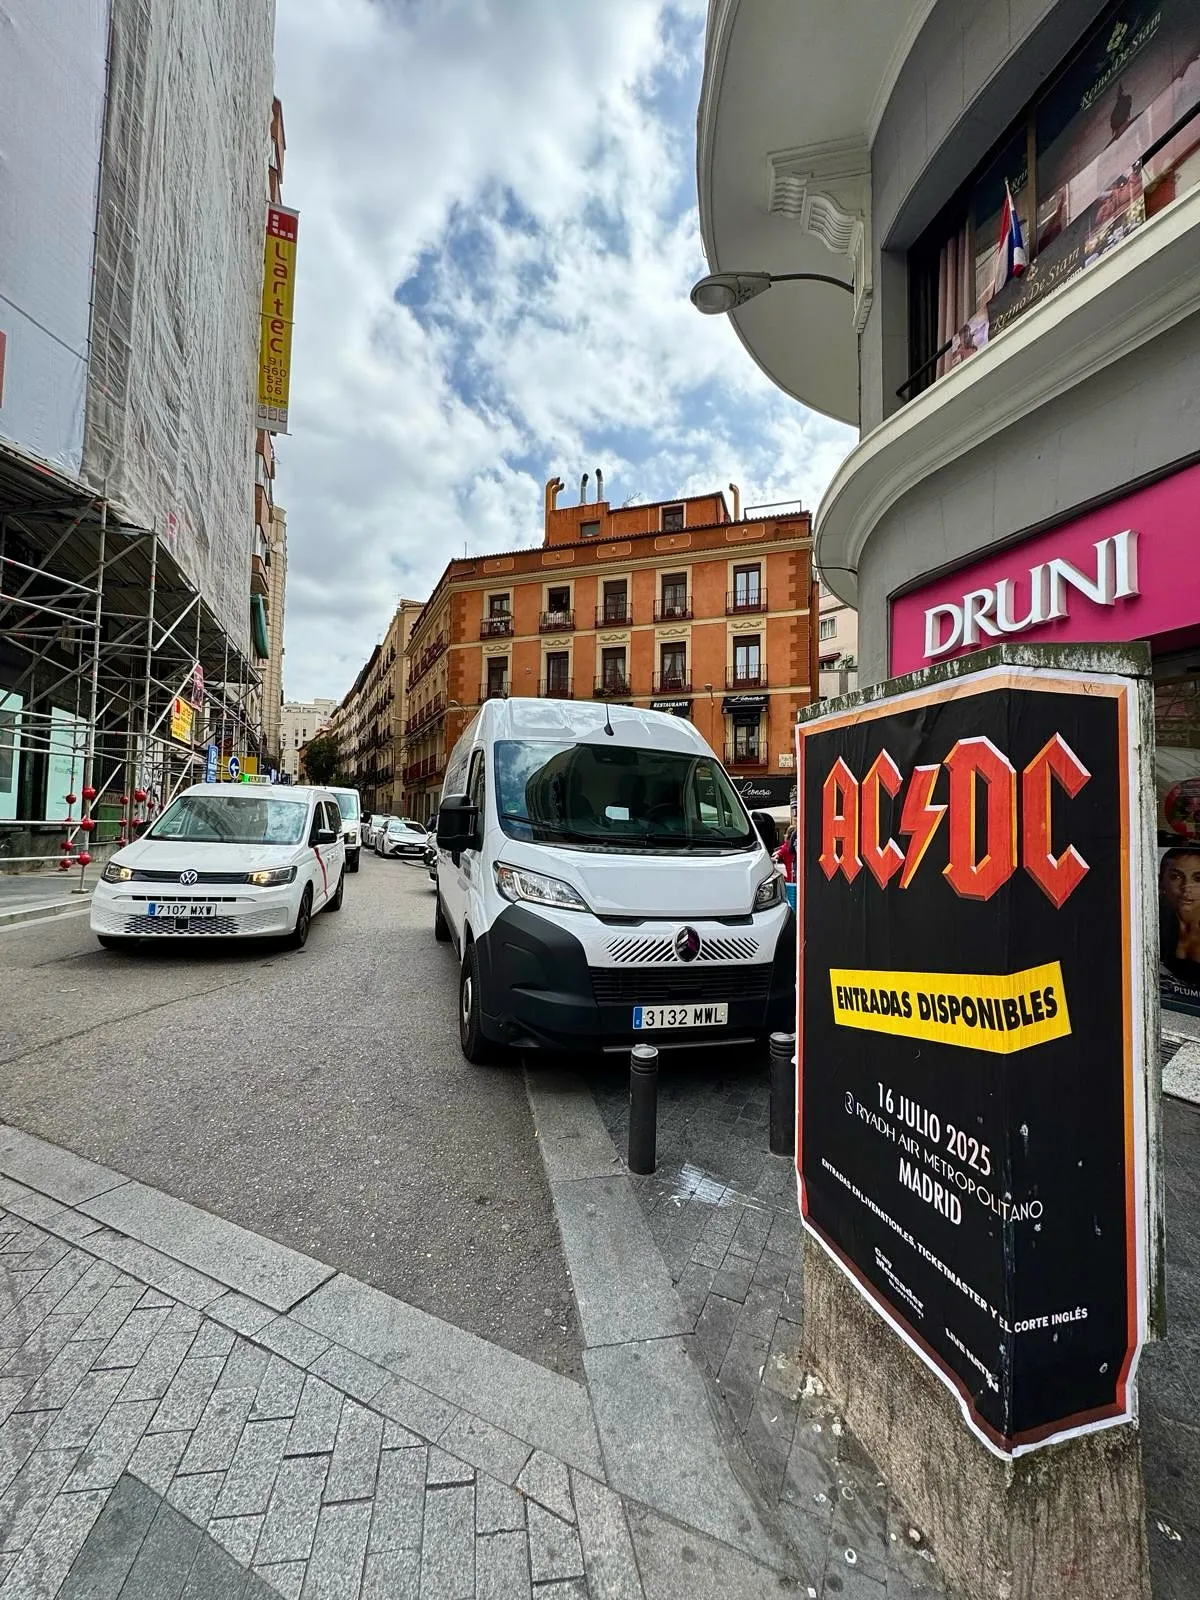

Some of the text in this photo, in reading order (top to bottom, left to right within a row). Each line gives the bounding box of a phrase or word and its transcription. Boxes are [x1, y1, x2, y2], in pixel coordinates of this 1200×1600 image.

[1129, 11, 1161, 55] Siam
[270, 242, 288, 353] Lartec
[993, 297, 1027, 331] Reino
[1028, 279, 1046, 301] De
[1046, 247, 1080, 287] Siam
[263, 365, 287, 377] 560
[923, 529, 1142, 658] DRUNI
[738, 781, 772, 799] Leonesa
[157, 905, 212, 916] 7107 MXW
[836, 985, 1058, 1031] ENTRADAS DISPONIBLES
[1173, 985, 1200, 998] PLUM
[645, 1007, 723, 1026] 3132 MWL
[877, 1082, 991, 1176] 16 JULIO 2025
[898, 1133, 920, 1159] AIR
[924, 1148, 1043, 1222] METROPOLITANO
[899, 1157, 962, 1225] MADRID
[821, 1157, 851, 1190] ENTRADAS
[851, 1185, 861, 1199] EN
[917, 1242, 988, 1312] TICKETMASTER
[989, 1304, 998, 1319] Y
[999, 1317, 1013, 1334] EL
[1014, 1316, 1049, 1333] CORTE
[1051, 1306, 1088, 1326] INGLÉS
[945, 1327, 966, 1355] LIVE
